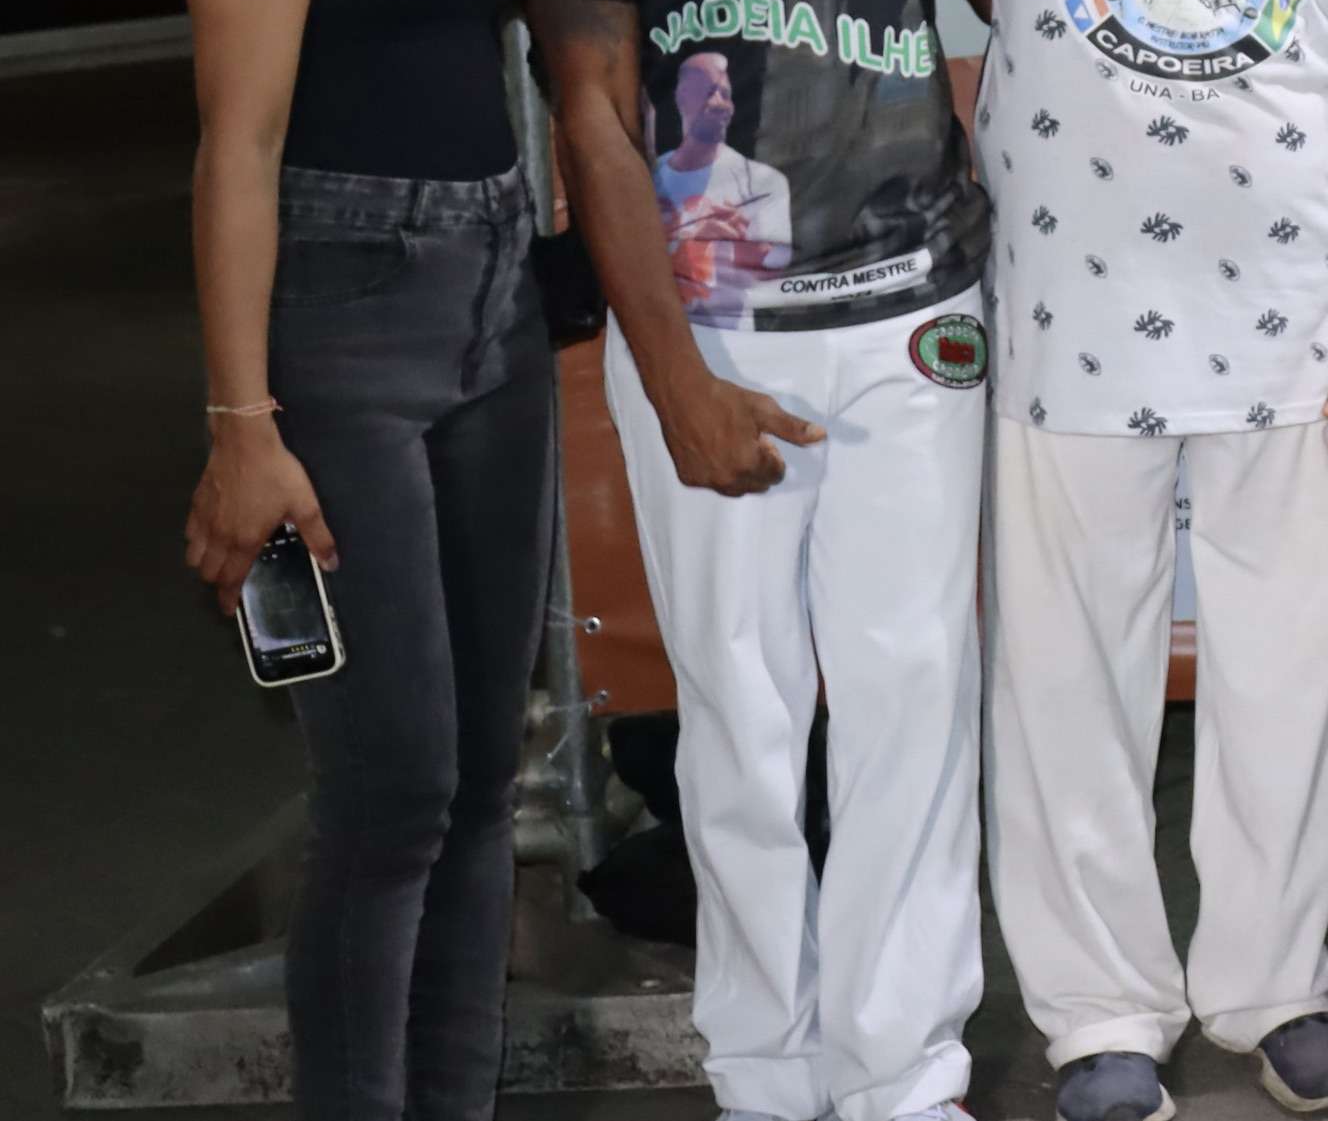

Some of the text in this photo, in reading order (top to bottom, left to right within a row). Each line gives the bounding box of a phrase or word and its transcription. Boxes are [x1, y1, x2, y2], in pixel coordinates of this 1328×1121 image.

[1095, 28, 1256, 76] CAPOEIRA
[1129, 80, 1221, 102] UNA BA
[780, 258, 918, 294] CONTRA MESTRE
